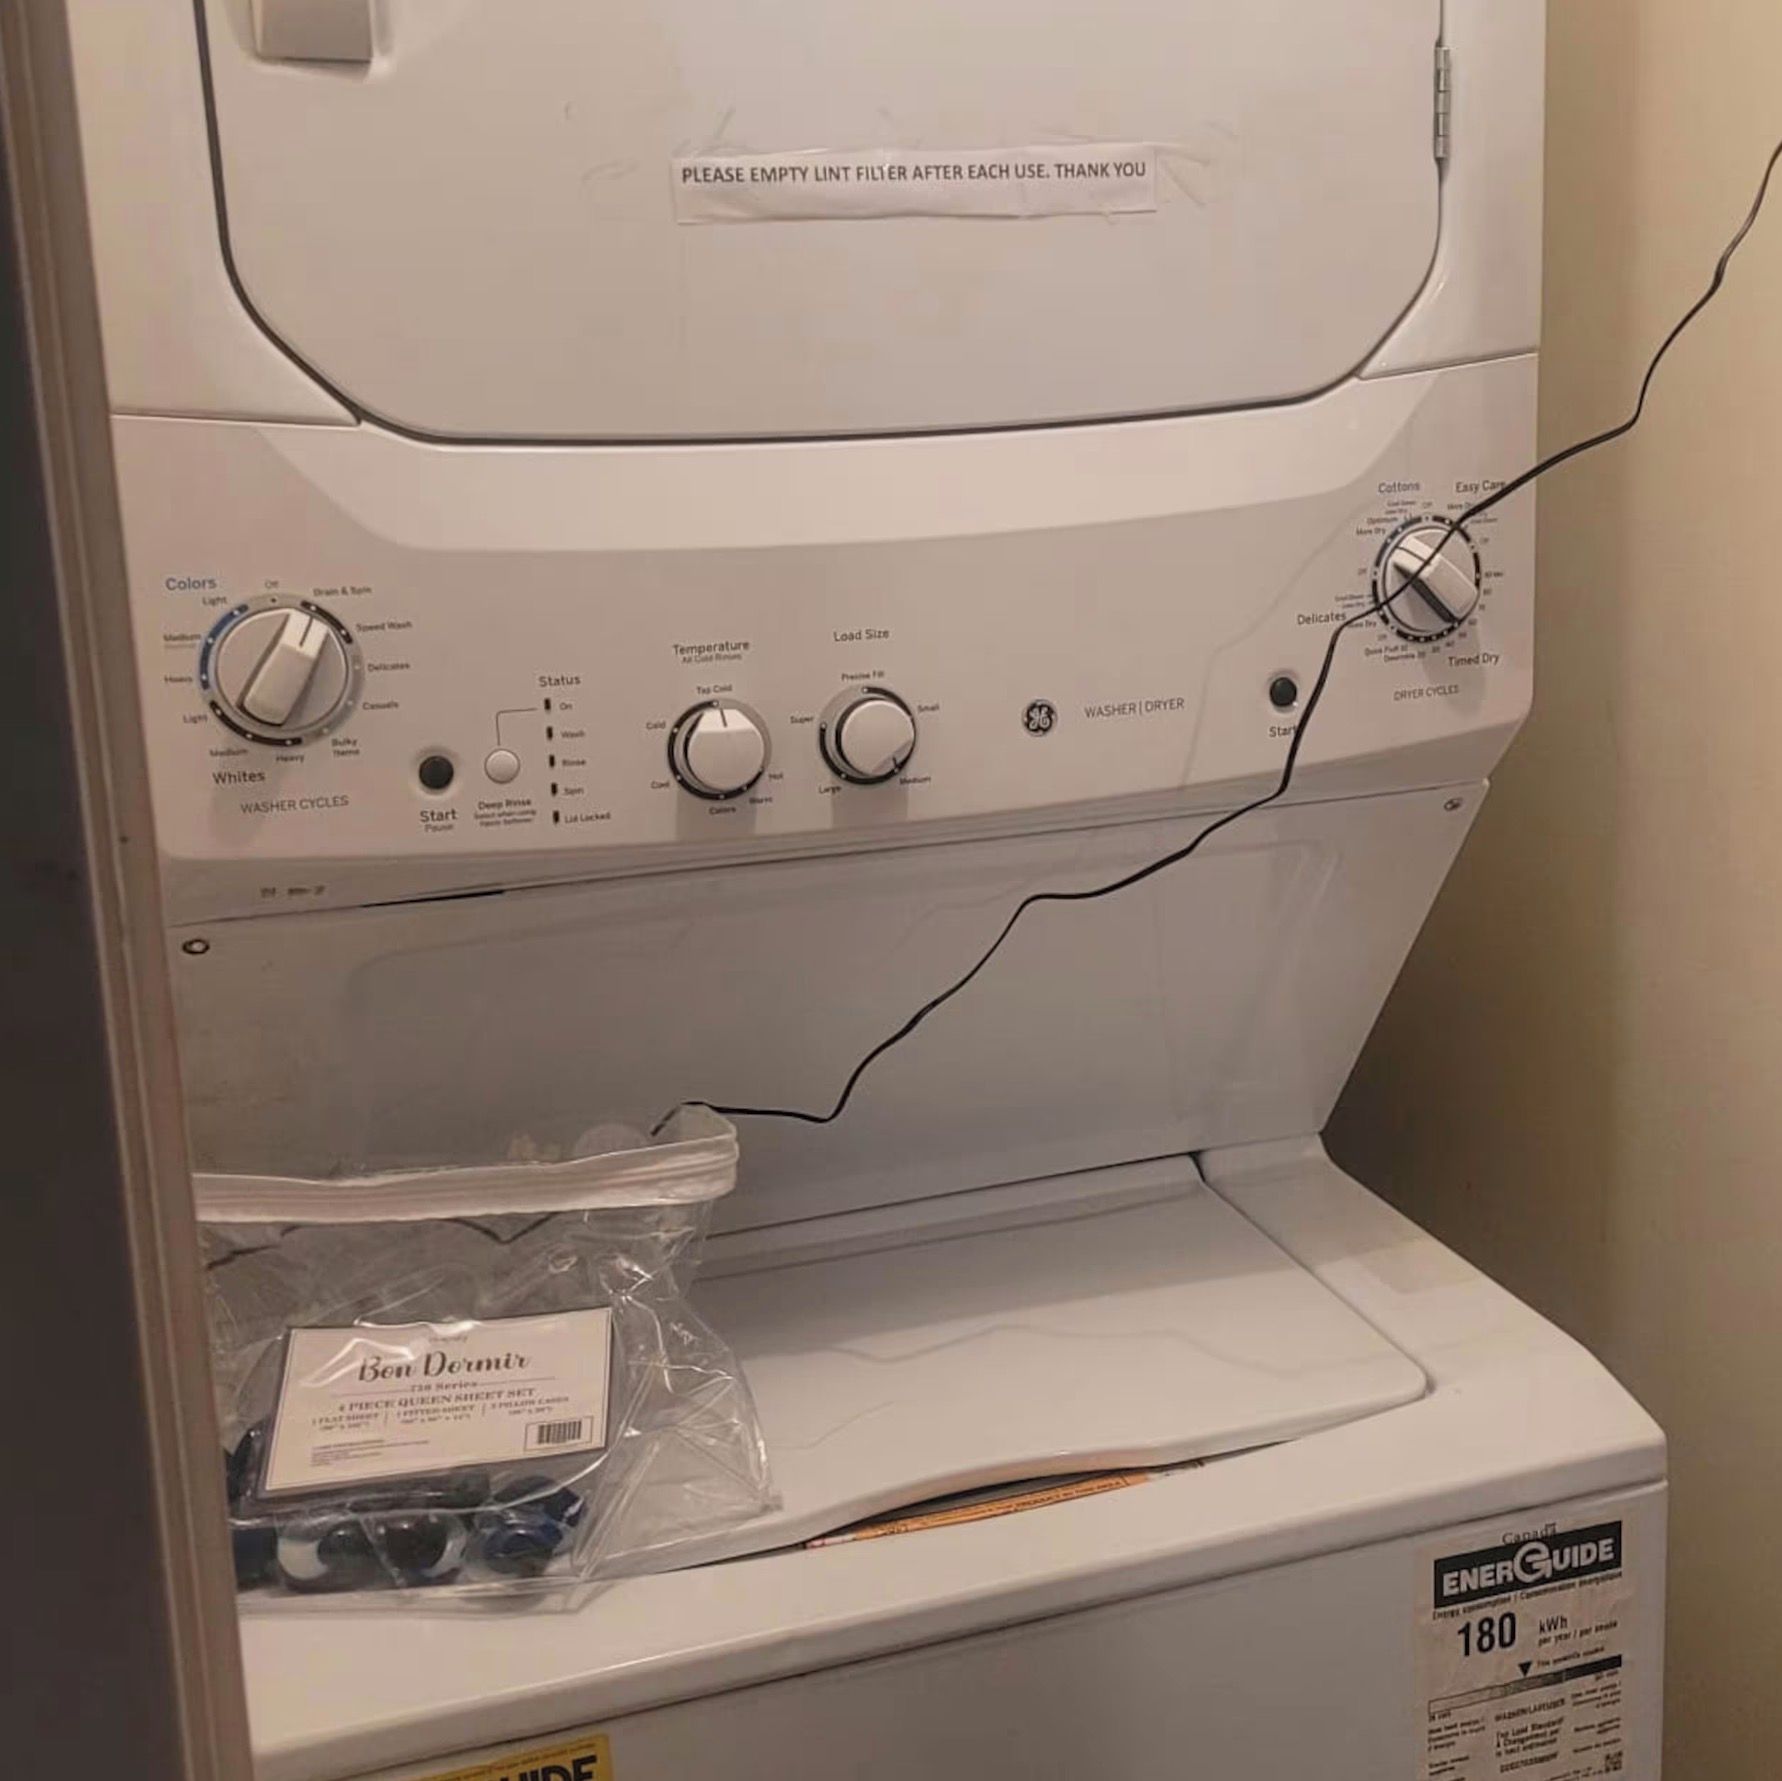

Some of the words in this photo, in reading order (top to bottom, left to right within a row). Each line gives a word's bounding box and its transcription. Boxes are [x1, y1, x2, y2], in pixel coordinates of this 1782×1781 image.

[682, 165, 745, 184] PLEASE
[750, 165, 809, 183] EMPTY
[814, 165, 850, 182] LINT
[856, 164, 907, 182] FILTER
[912, 163, 963, 181] AFTER
[967, 162, 1009, 180] EACH
[1015, 162, 1050, 179] USE.
[1054, 161, 1109, 179] THANK
[1112, 161, 1146, 178] YOU
[1378, 482, 1420, 495] Cottons
[1455, 482, 1481, 495] Easy
[165, 577, 217, 592] Colors
[313, 588, 338, 598] Drain
[341, 587, 348, 596] &
[350, 585, 372, 596] Spin
[202, 595, 227, 606] Light
[1297, 612, 1347, 626] Delicates
[356, 622, 385, 634] Speed
[386, 620, 412, 630] Wash
[833, 630, 862, 643] Load
[865, 628, 890, 641] Size
[673, 640, 750, 657] Temperature
[367, 662, 411, 672] Delicates
[1448, 654, 1480, 668] Timed
[1481, 652, 1500, 666] Dry
[538, 674, 582, 688] Status
[713, 684, 733, 694] Cold
[1393, 689, 1424, 702] DRYER
[1425, 684, 1460, 698] CYCLES
[559, 702, 573, 711] On
[182, 713, 208, 725] Light
[1269, 725, 1298, 738] Start
[212, 770, 266, 786] Whites
[240, 799, 298, 815] WASHER
[299, 796, 350, 811] CYCLES
[478, 801, 503, 812] Deep
[420, 808, 457, 823] Start
[564, 814, 580, 825] Lid
[581, 811, 612, 822] Locked
[359, 1354, 417, 1383] Bon
[423, 1349, 532, 1378] Dormir
[349, 1399, 394, 1412] PIECE
[397, 1395, 452, 1408] QUEEN
[453, 1390, 502, 1403] SHEET
[505, 1387, 537, 1398] SET
[1502, 1522, 1557, 1545] Canada
[1442, 1537, 1615, 1597] ENERGUIDE
[1538, 1615, 1569, 1634] kWh
[1457, 1611, 1517, 1657] 180
